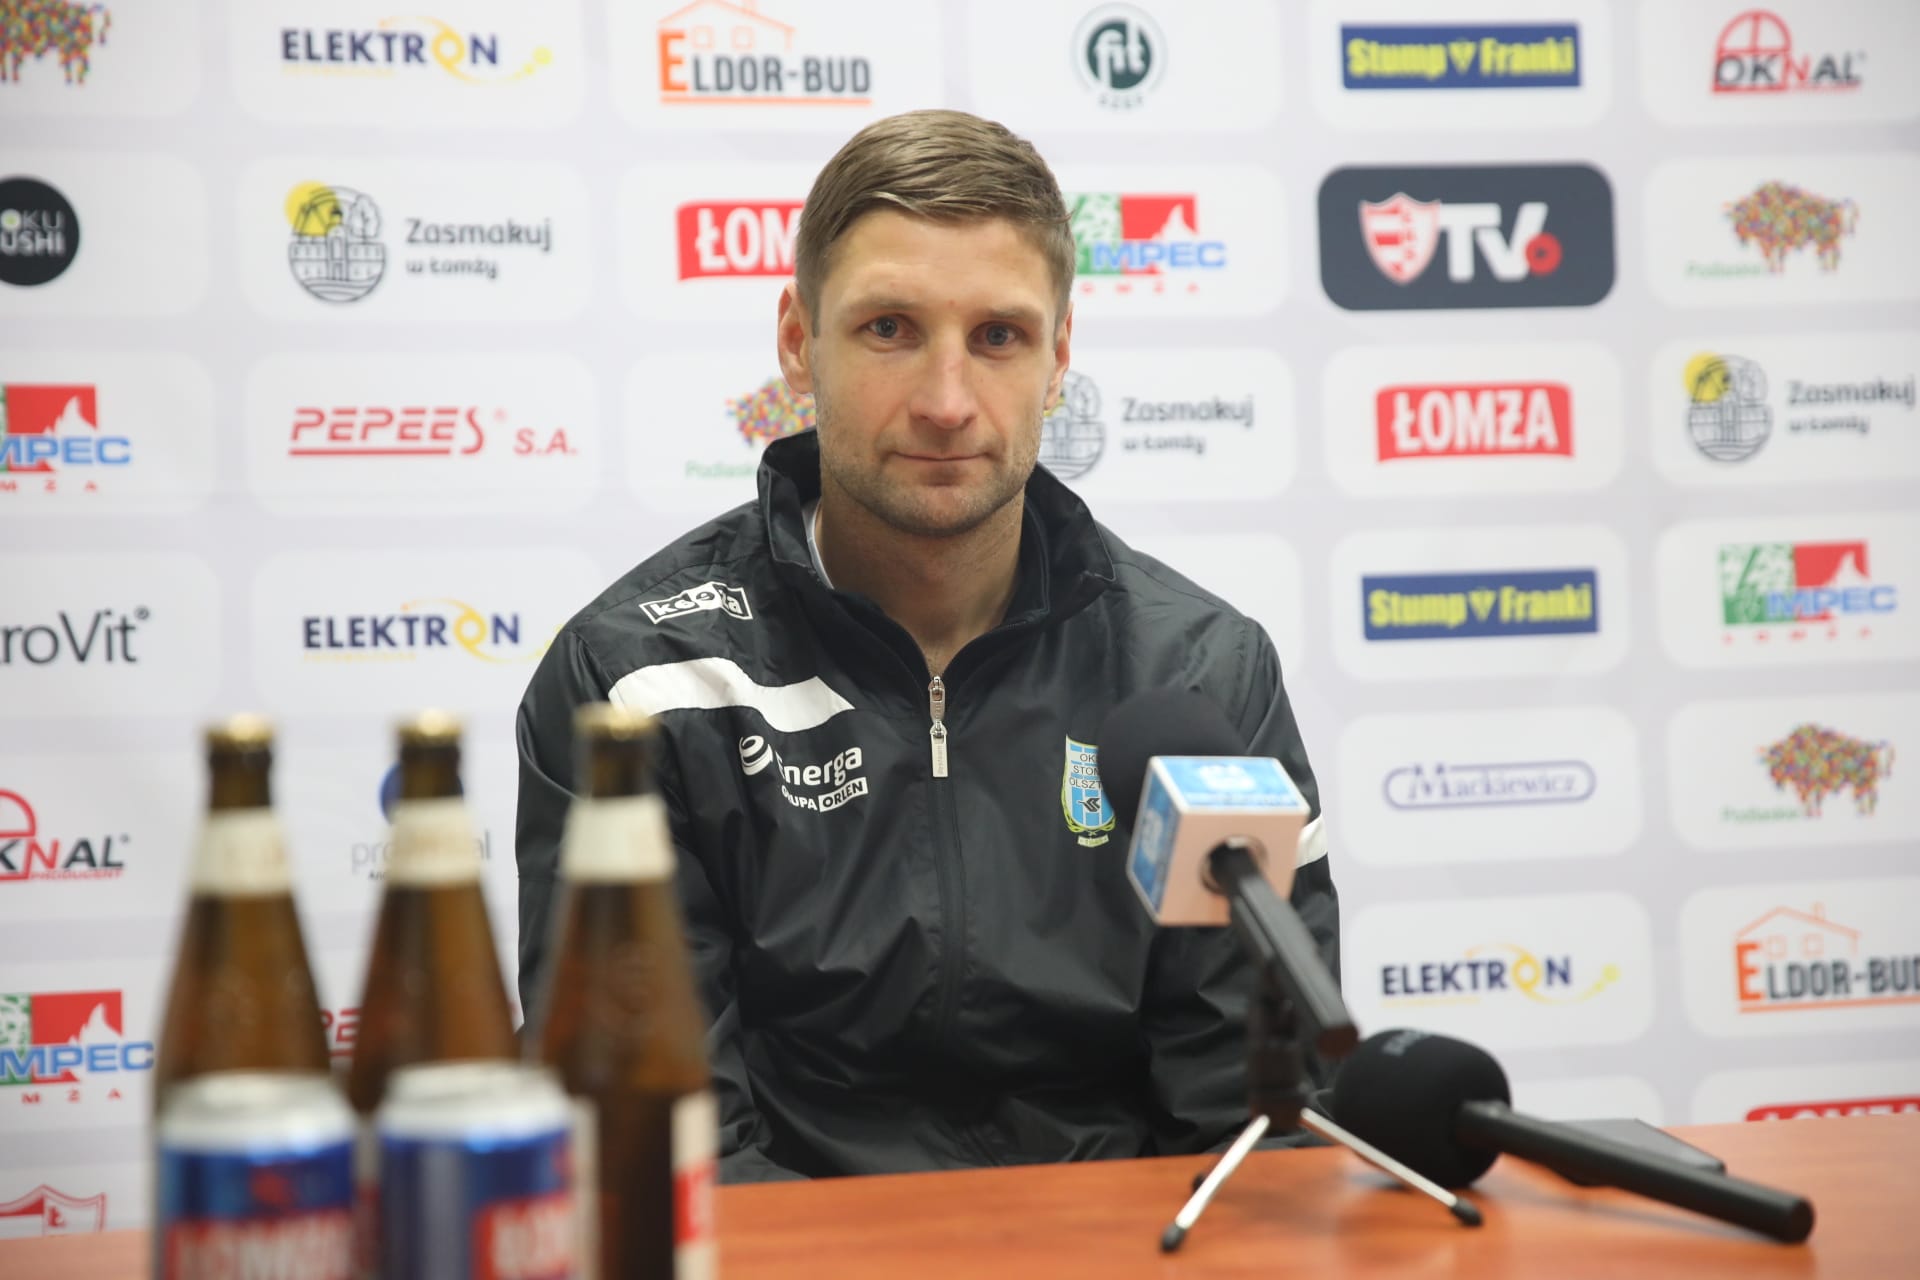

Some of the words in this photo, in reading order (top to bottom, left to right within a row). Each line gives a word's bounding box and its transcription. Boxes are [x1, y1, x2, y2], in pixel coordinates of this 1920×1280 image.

[281, 27, 498, 68] ELEKTRON
[658, 31, 871, 93] ELDOR-BUD
[1348, 38, 1447, 80] Stump
[1480, 36, 1574, 77] Franki
[405, 217, 552, 252] Zasmakuj
[695, 207, 803, 271] ŁOM
[1093, 241, 1226, 268] MPEC
[1122, 394, 1254, 427] Zasmakuj
[1787, 374, 1915, 408] Zasmakuj
[290, 407, 484, 455] PEPEES
[514, 427, 578, 455] S.A.
[1369, 588, 1468, 629] Stump
[1500, 583, 1592, 622] Franki
[303, 612, 520, 648] ELEKTRON
[822, 780, 864, 808] ORLEN
[1381, 955, 1571, 996] ELEKTRON
